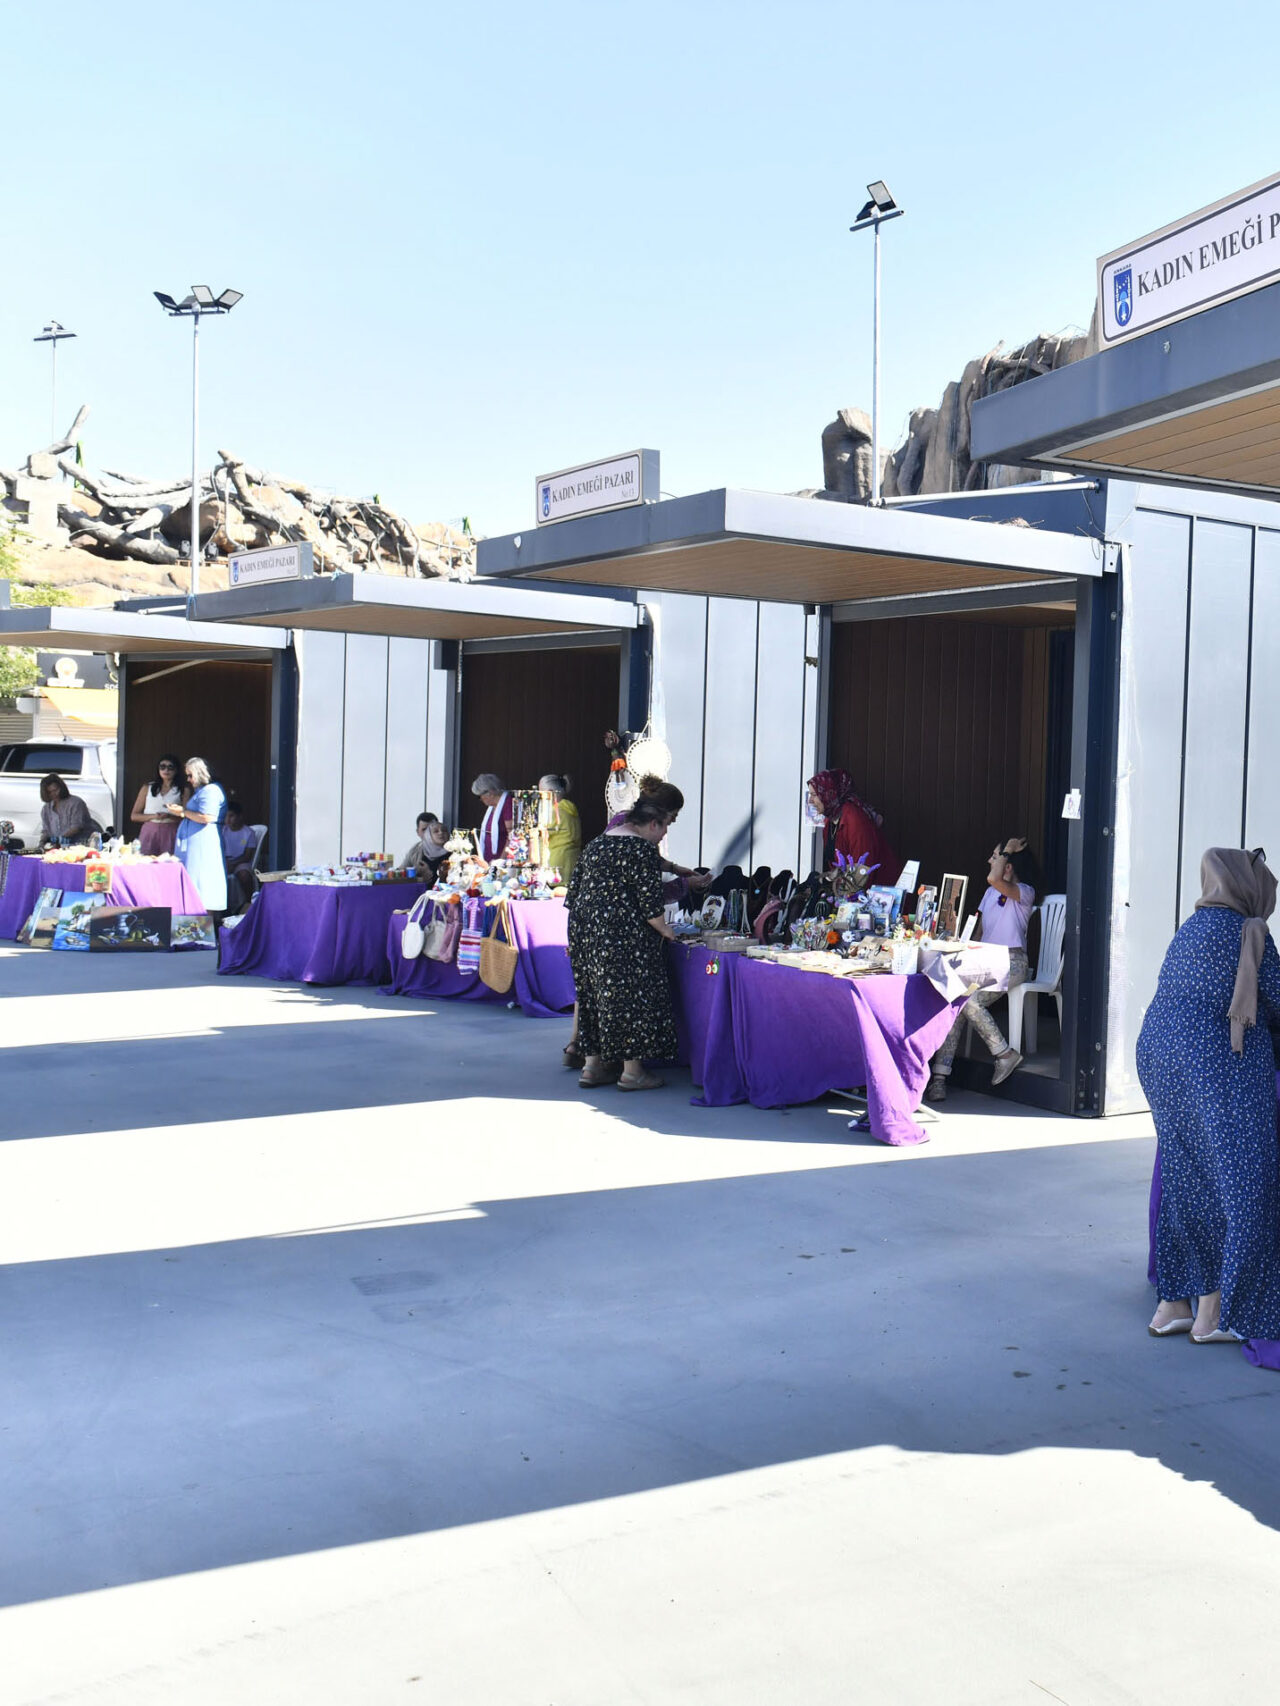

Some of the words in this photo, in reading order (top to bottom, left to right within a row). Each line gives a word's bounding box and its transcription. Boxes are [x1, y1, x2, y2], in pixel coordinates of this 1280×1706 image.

[1138, 251, 1194, 297] KADIN
[1199, 214, 1264, 271] EMEĞİ
[552, 486, 576, 503] KADIN
[577, 475, 602, 496] EMEĞİ
[604, 470, 634, 489] PAZARI
